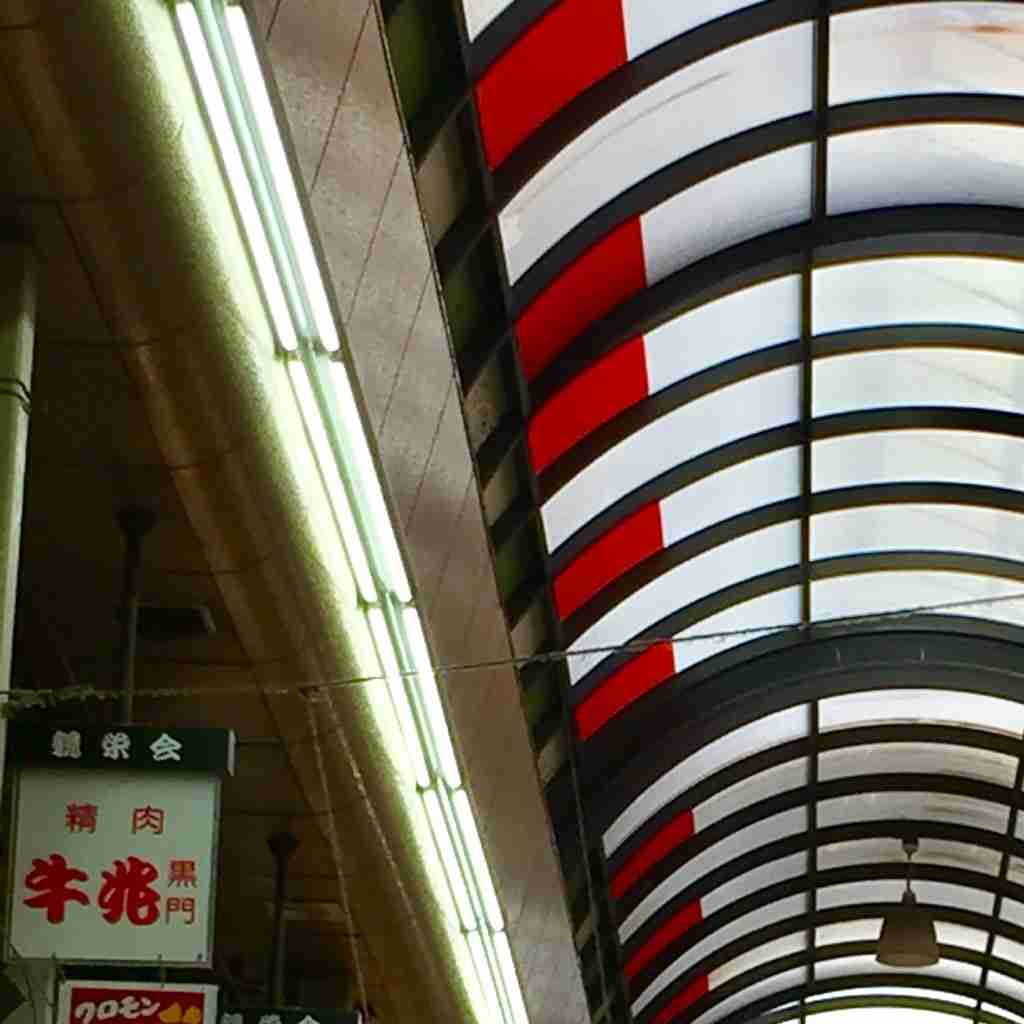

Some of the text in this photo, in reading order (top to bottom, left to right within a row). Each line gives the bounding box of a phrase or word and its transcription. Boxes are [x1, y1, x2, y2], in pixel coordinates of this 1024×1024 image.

[165, 859, 199, 925] 黒門
[75, 995, 161, 1024] クロモン
